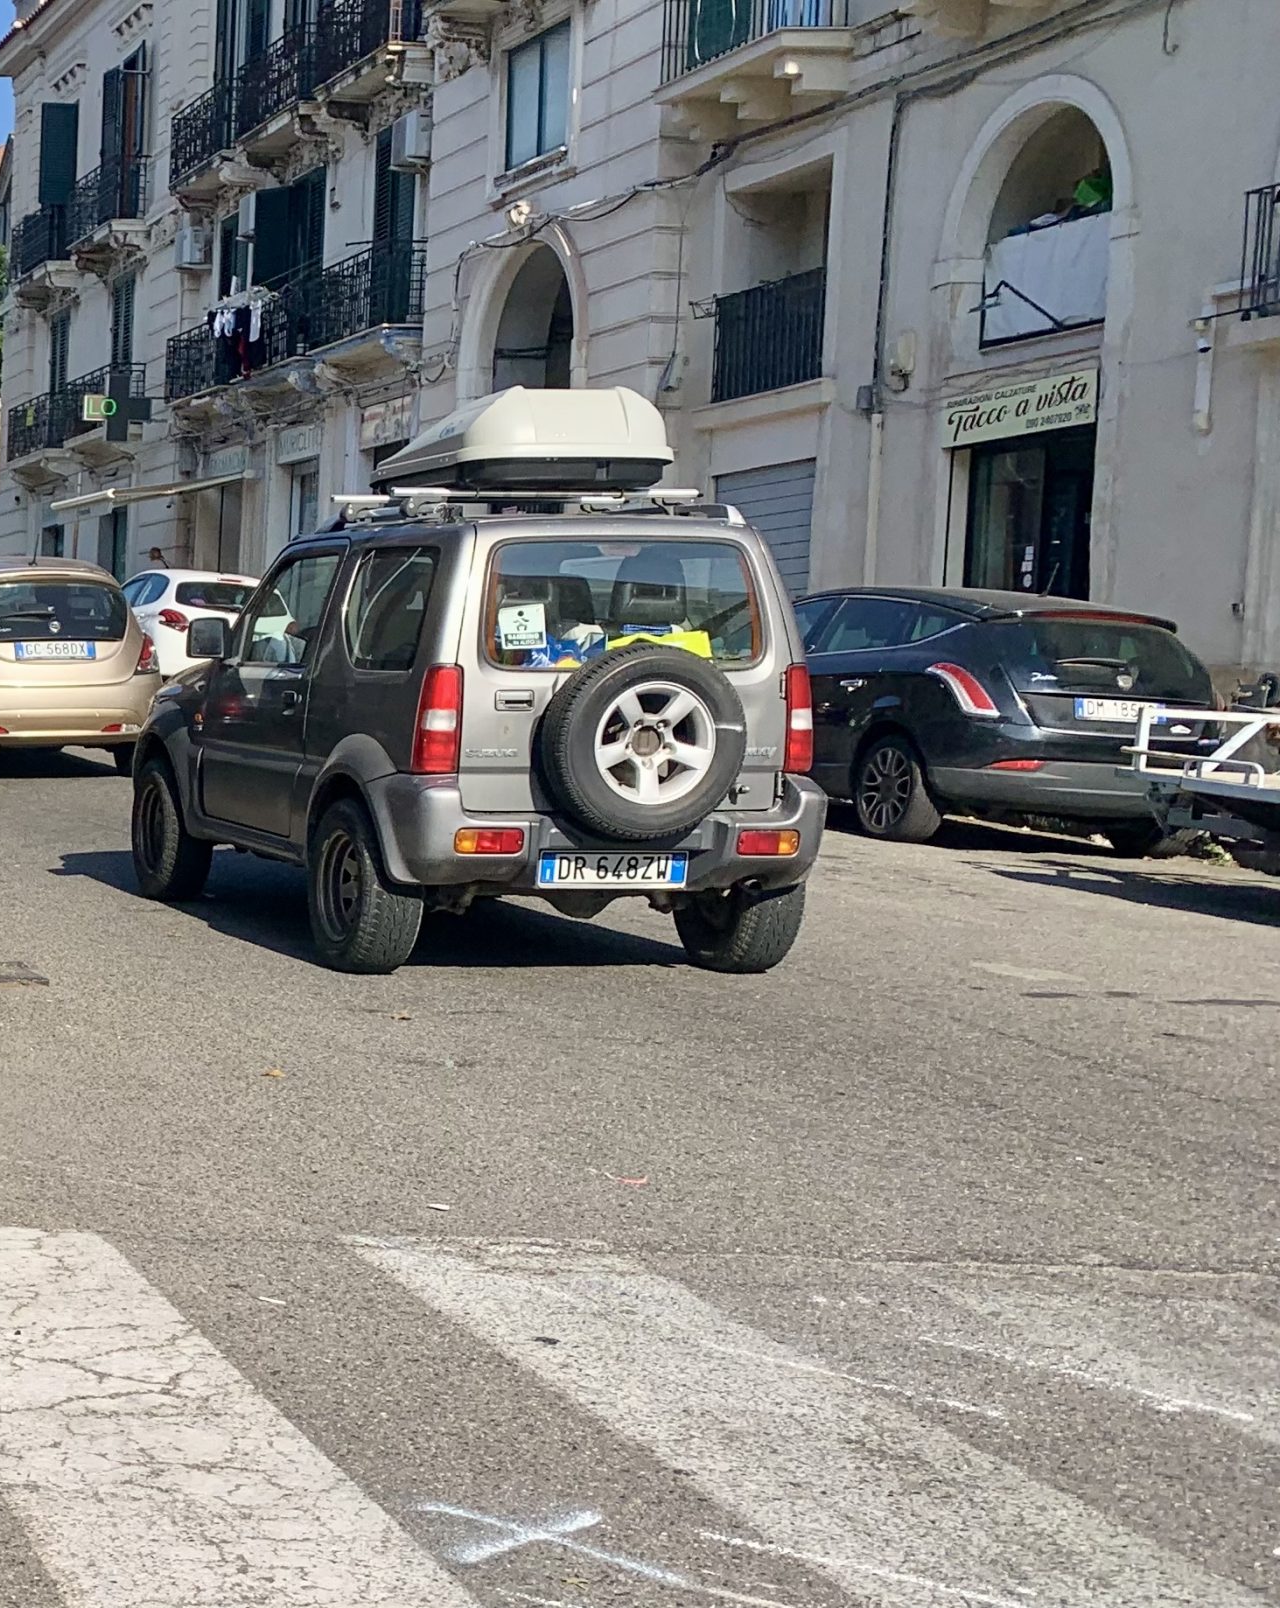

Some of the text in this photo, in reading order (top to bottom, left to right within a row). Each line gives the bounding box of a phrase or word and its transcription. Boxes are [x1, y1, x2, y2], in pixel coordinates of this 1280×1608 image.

[994, 384, 1038, 401] CALZATURE
[948, 375, 1091, 442] Tacco a vista
[558, 855, 671, 881] DR 648ZW
